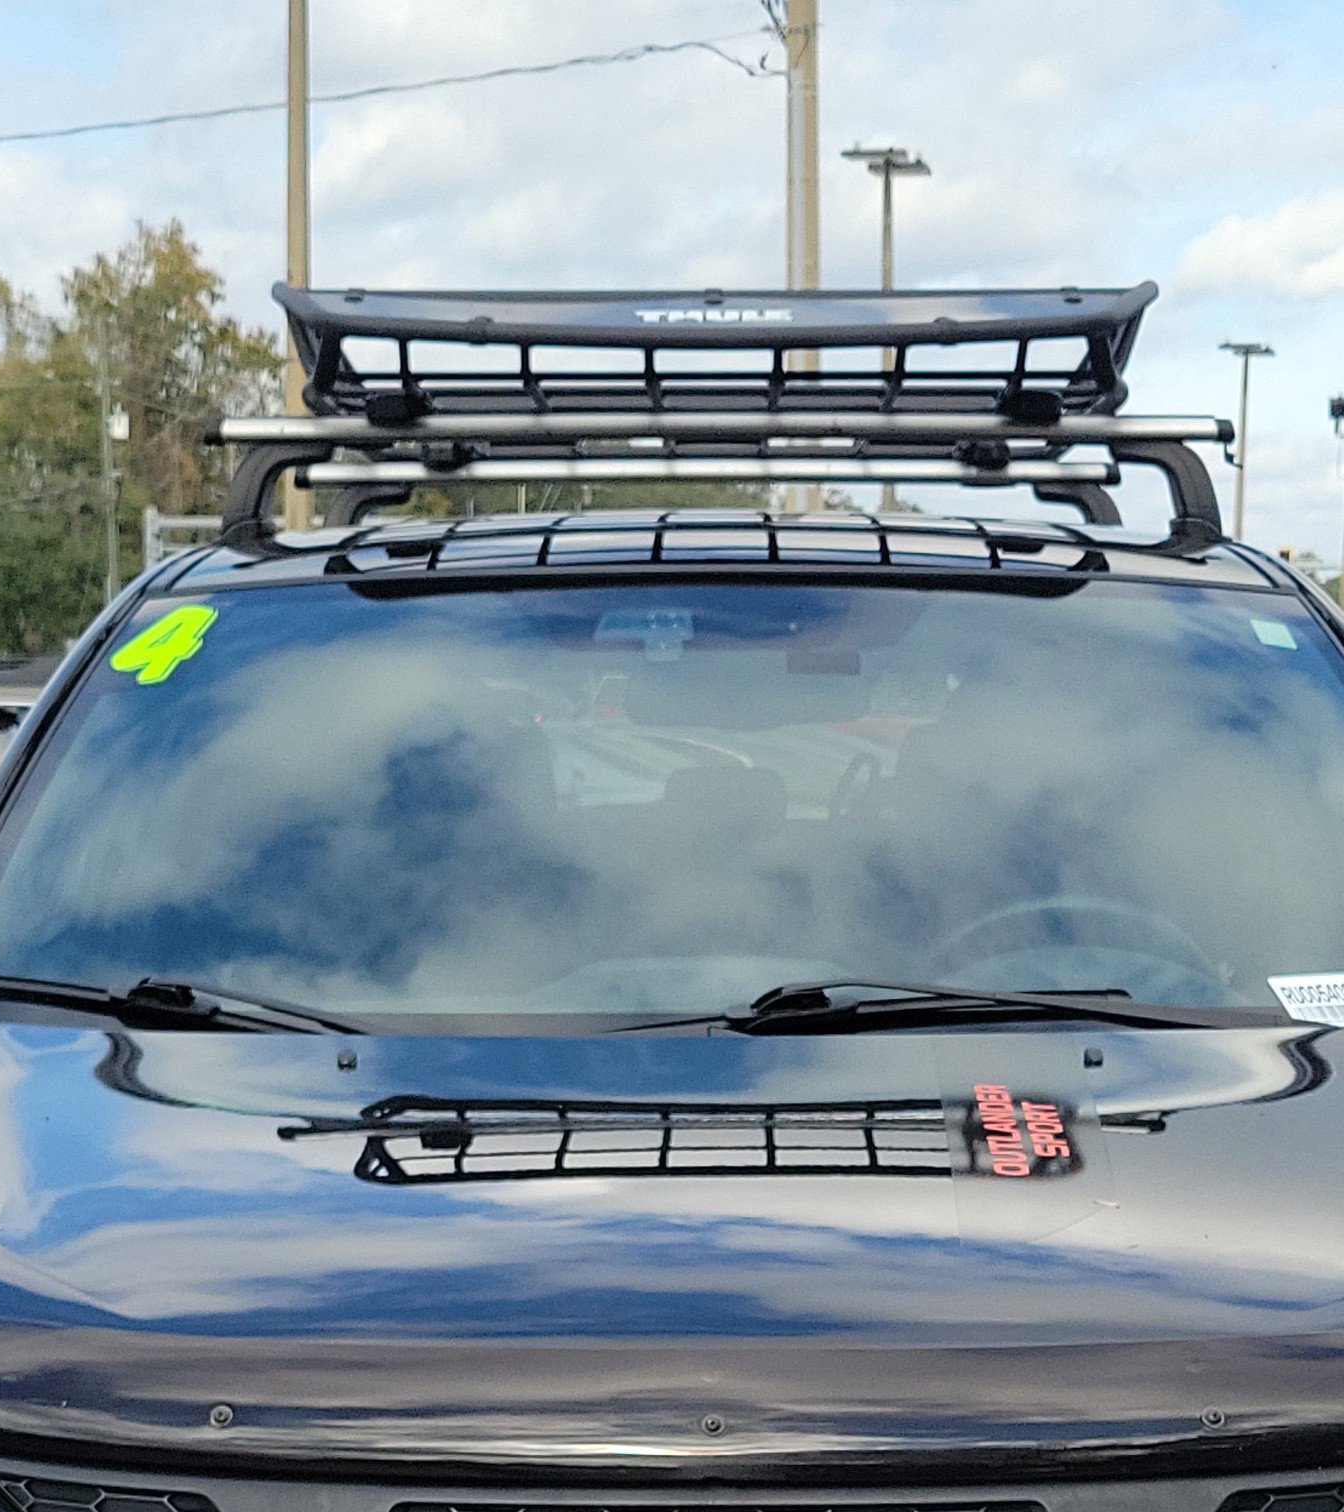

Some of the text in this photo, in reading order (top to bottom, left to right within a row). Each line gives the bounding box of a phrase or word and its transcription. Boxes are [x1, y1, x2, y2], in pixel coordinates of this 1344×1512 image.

[110, 605, 219, 684] 4
[974, 1083, 1030, 1177] OUTLANDER
[1021, 1100, 1071, 1158] SPORT
